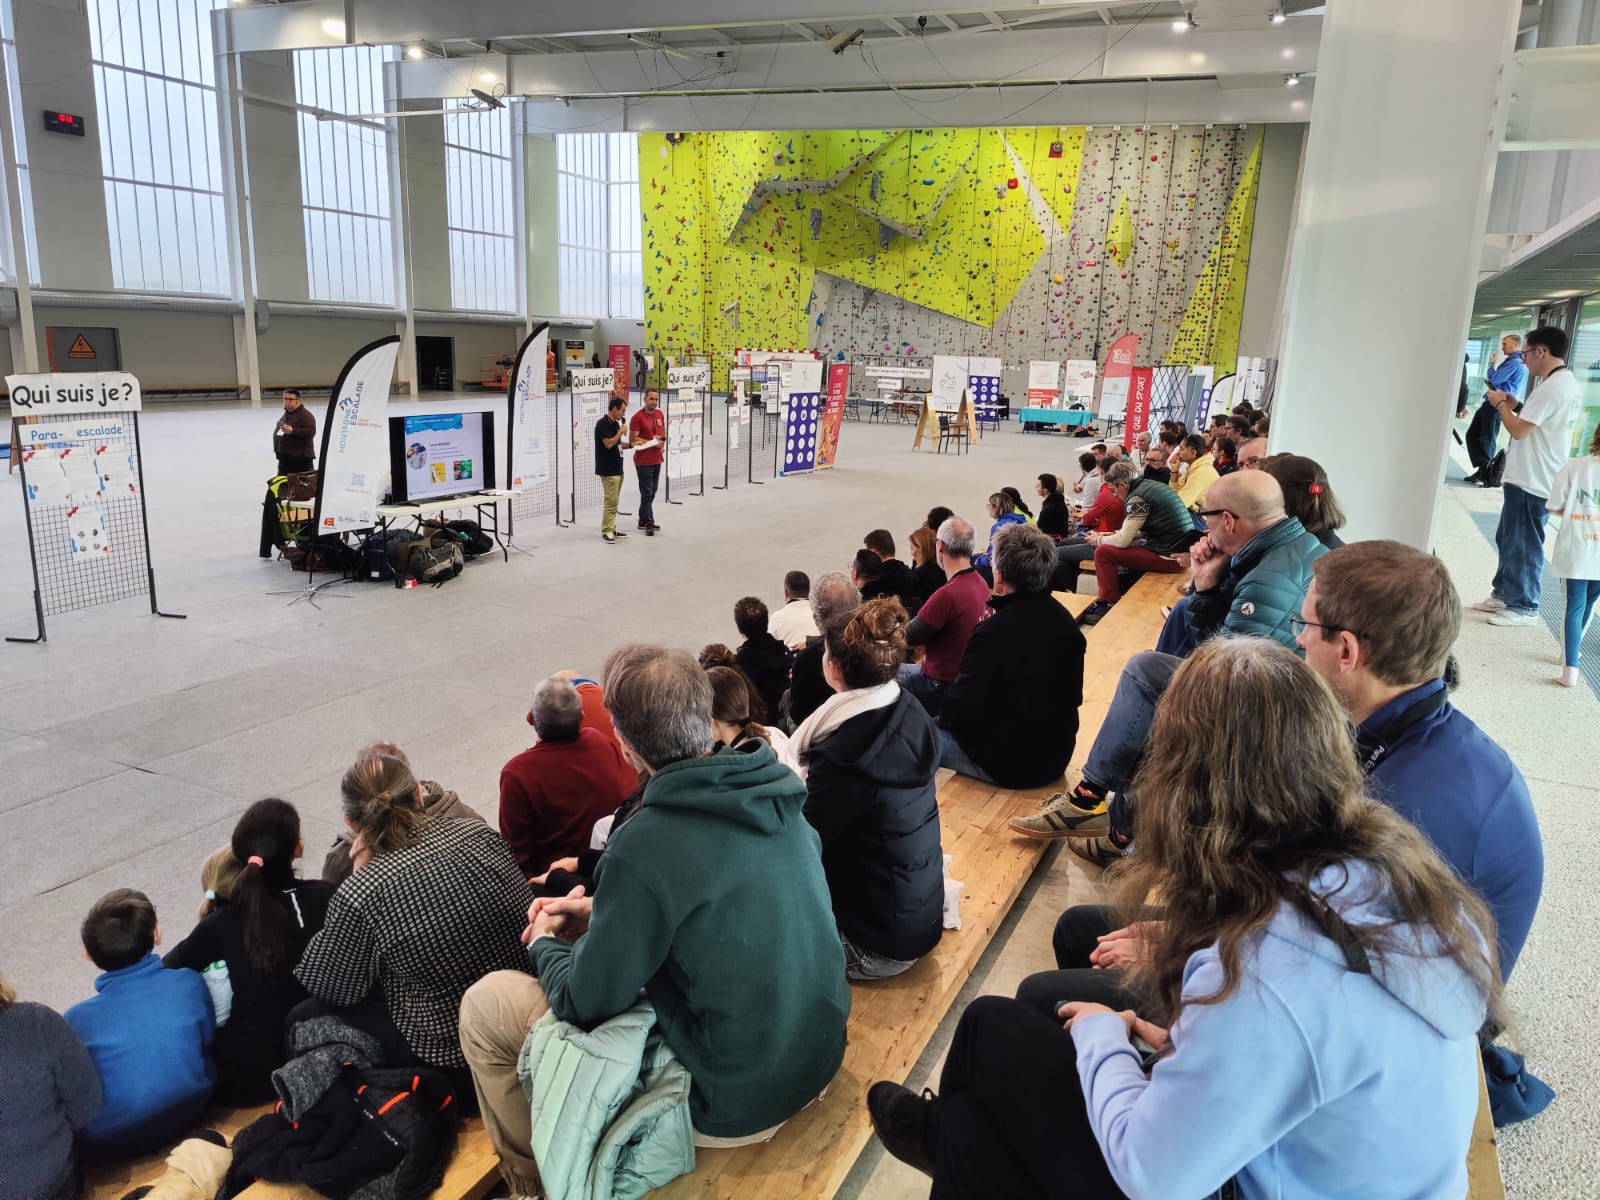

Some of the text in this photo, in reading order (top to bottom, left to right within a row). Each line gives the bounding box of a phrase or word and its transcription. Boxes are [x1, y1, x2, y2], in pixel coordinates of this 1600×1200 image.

[573, 375, 586, 389] Qui
[588, 374, 602, 386] suis
[669, 373, 680, 385] Qui
[682, 371, 695, 383] suis
[12, 385, 51, 408] Qui
[56, 384, 94, 403] suis
[1135, 376, 1146, 400] SPORT
[350, 380, 364, 426] ESCALADE
[1134, 401, 1143, 413] DU
[1132, 415, 1142, 430] QUE
[31, 425, 123, 441] Para- escalade
[1371, 745, 1385, 761] Para
